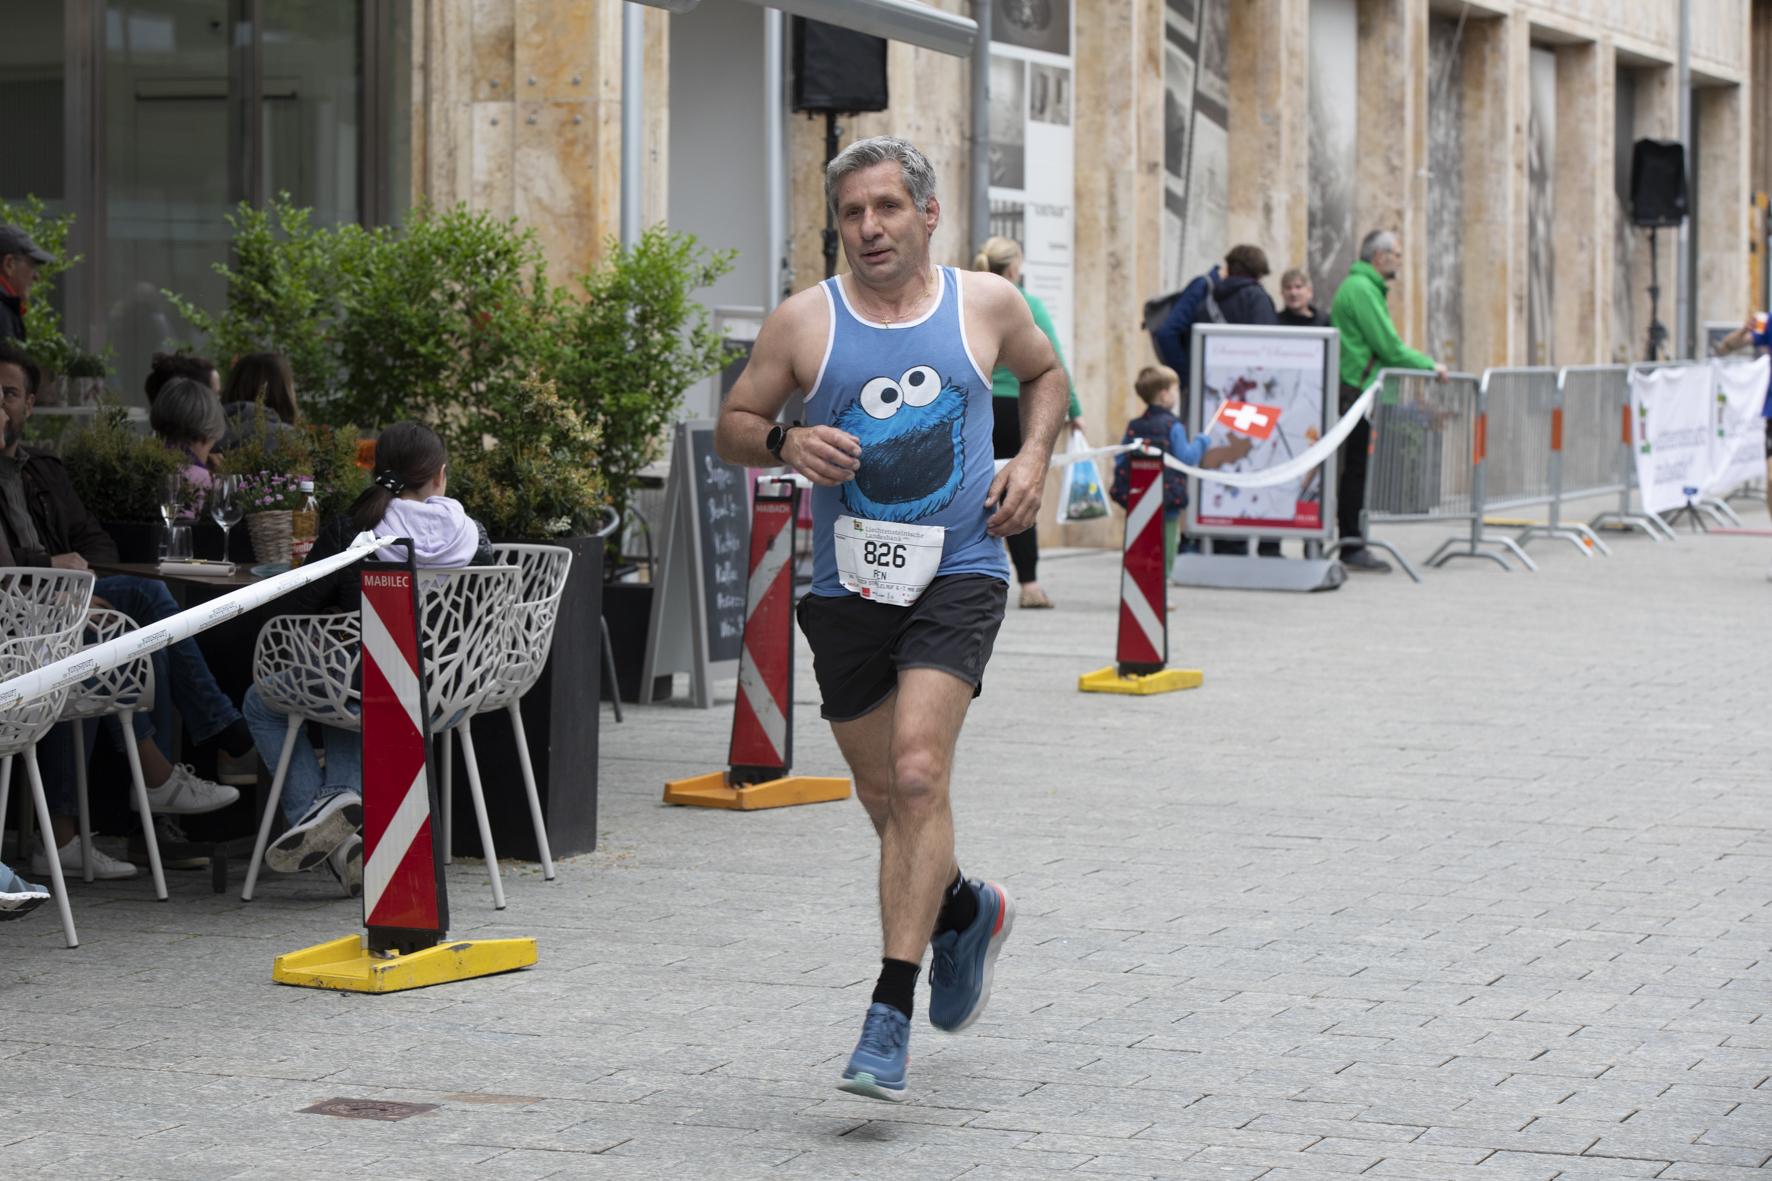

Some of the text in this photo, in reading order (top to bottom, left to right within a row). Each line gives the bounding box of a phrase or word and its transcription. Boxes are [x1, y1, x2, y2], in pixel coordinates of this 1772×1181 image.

[865, 526, 925, 538] Liechtensteinische
[865, 532, 902, 542] Landesbank
[864, 541, 907, 569] 826
[364, 575, 409, 588] MABILEC
